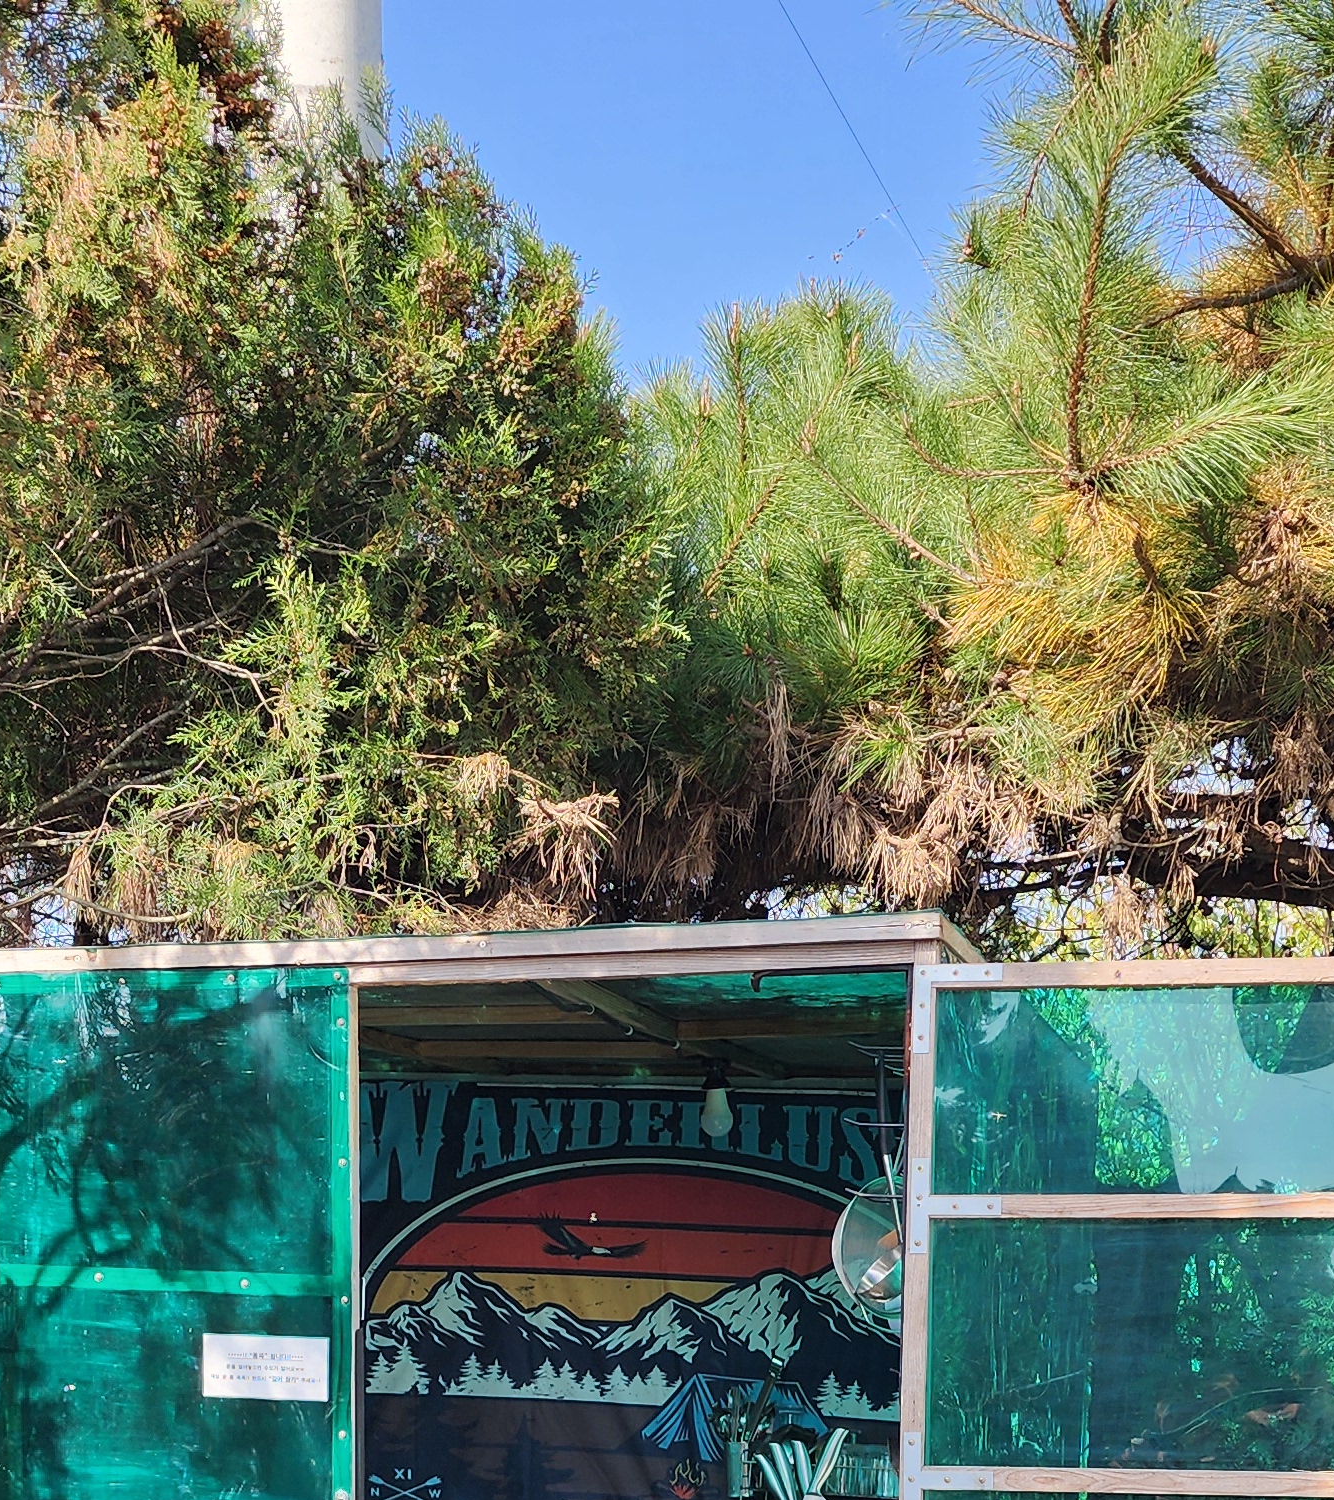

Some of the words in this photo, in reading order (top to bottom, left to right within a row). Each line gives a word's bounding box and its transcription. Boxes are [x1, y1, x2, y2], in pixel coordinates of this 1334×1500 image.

[360, 1081, 880, 1202] WANDERLUS
[393, 1468, 412, 1480] XI
[370, 1487, 380, 1497] N
[428, 1488, 442, 1498] W
